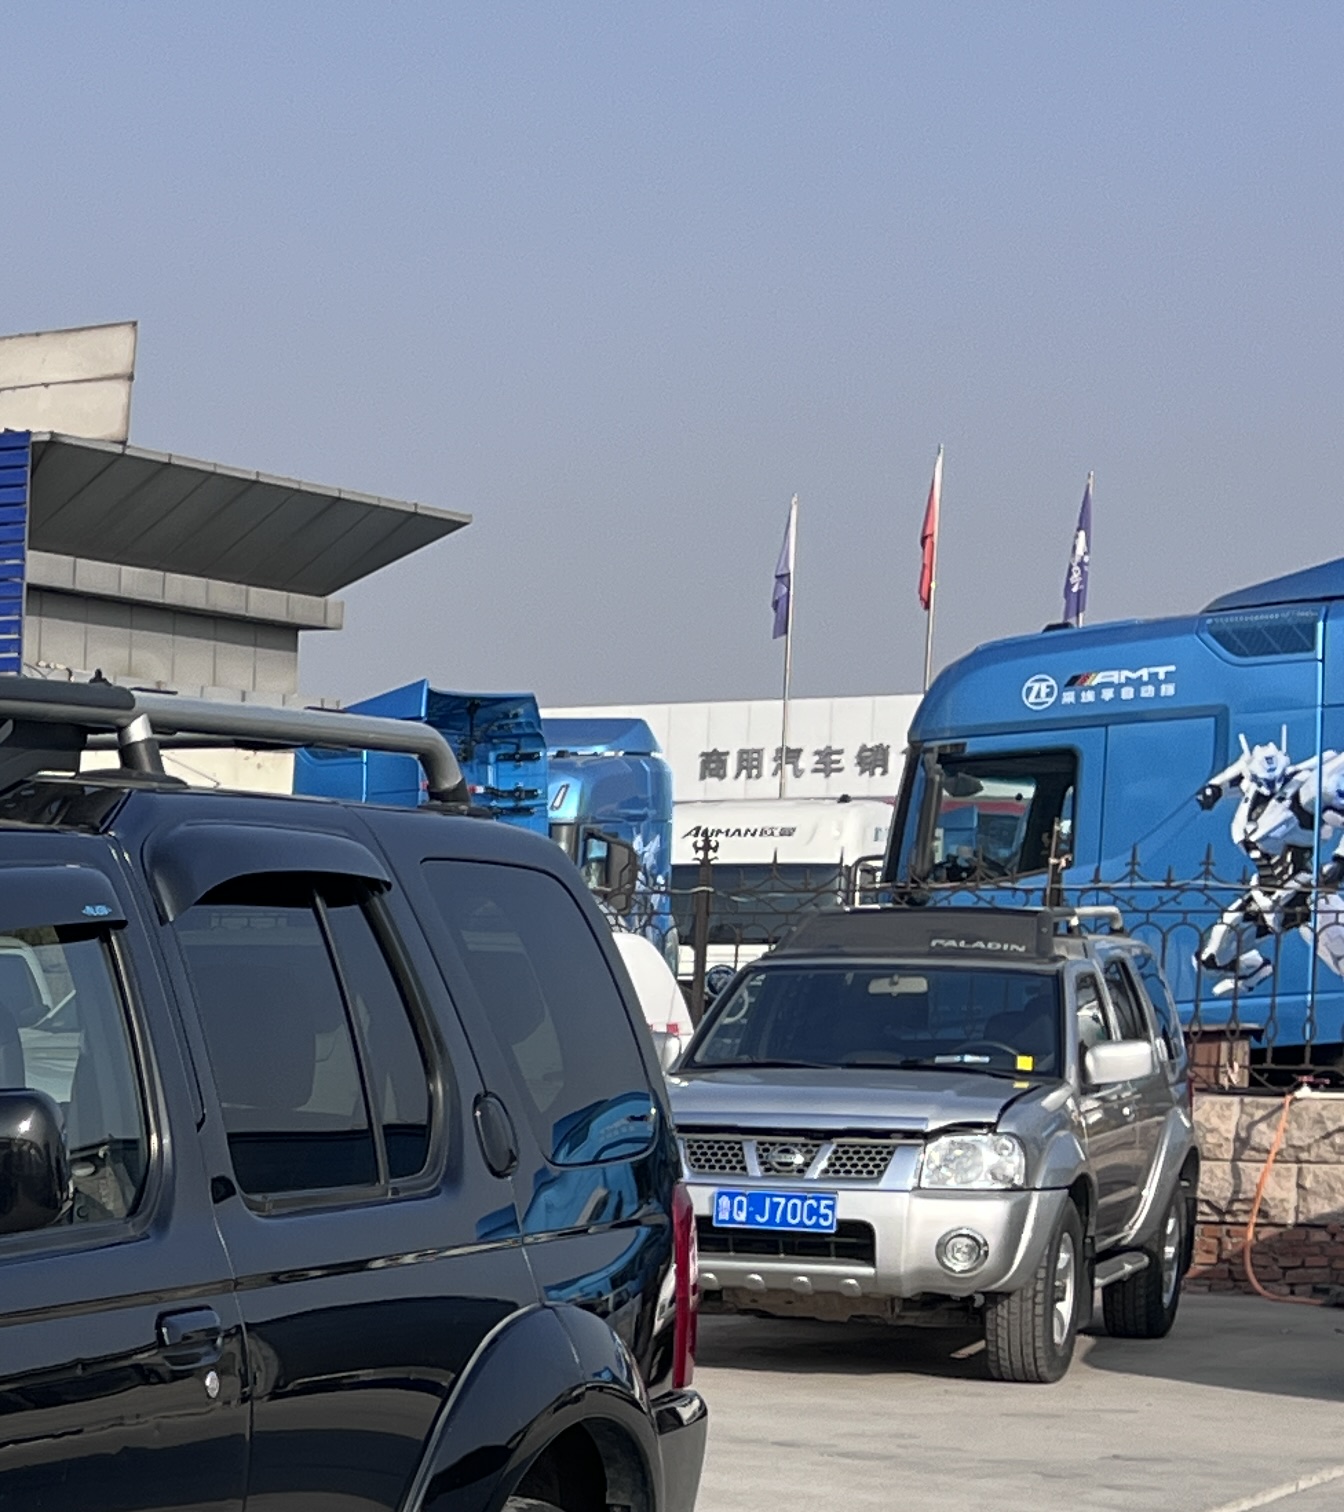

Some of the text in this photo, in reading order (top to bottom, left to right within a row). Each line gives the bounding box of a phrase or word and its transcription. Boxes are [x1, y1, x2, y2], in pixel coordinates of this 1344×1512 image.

[698, 743, 911, 782] 商用汽车销
[930, 938, 1027, 953] PALADIN
